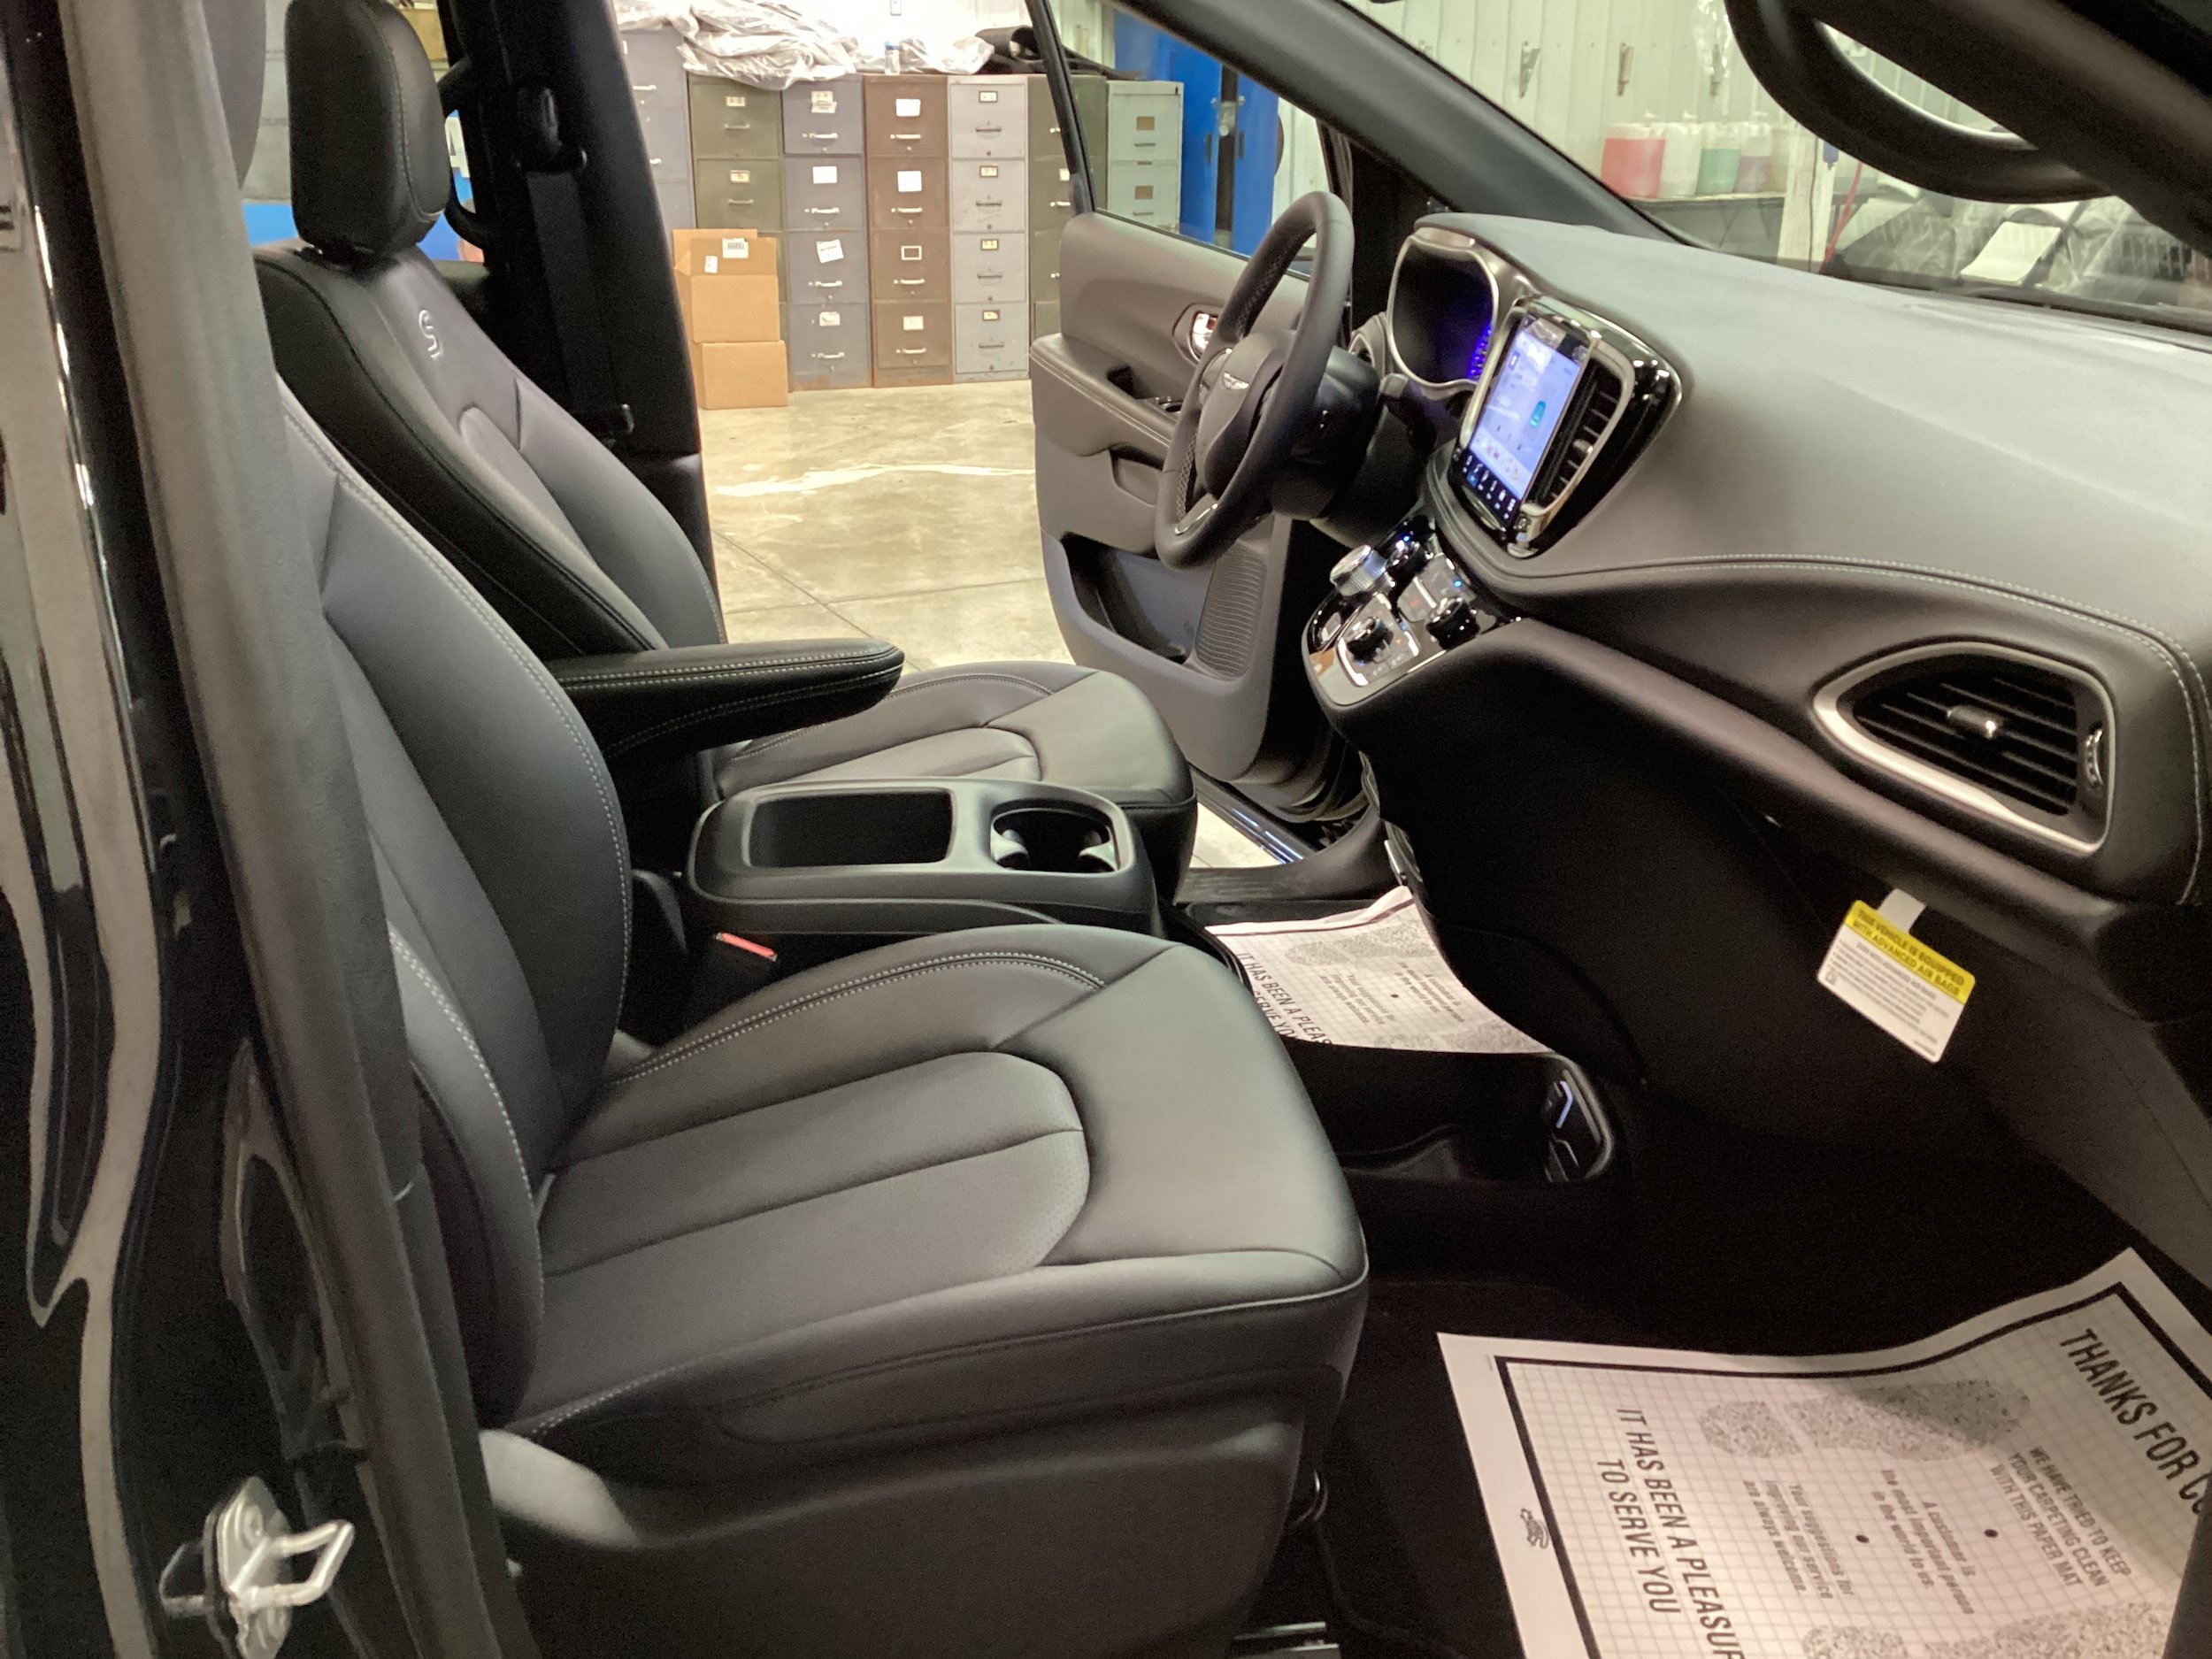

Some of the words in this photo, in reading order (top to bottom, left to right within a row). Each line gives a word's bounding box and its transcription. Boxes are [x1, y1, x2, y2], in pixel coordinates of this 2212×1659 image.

[1872, 933, 1917, 968] ADVANCED
[1917, 965, 1934, 978] AIR
[1934, 975, 1960, 996] BAGS
[1875, 924, 1908, 949] VEHICLE
[1919, 952, 1964, 986] EQUIPPED
[1245, 961, 1272, 981] HAS
[1262, 982, 1296, 1006] BEEN
[1617, 1409, 1647, 1425] IT
[2060, 1328, 2158, 1425] THANKS
[2133, 1422, 2200, 1480] FOR
[1596, 1459, 1630, 1484] TO
[1625, 1432, 1665, 1471] HAS
[1609, 1492, 1660, 1557] SERVE
[1644, 1479, 1690, 1529] BEEN
[1753, 1501, 1780, 1538] always
[1990, 1464, 2020, 1494] WITH
[2009, 1494, 2038, 1521] THIS
[2027, 1522, 2063, 1560] PAPER
[2053, 1562, 2082, 1586] MAT
[2008, 1453, 2038, 1484] YOUR
[2028, 1483, 2081, 1547] CARPETING
[2072, 1548, 2109, 1586] CLEAN
[2030, 1446, 2051, 1464] WE
[2041, 1464, 2071, 1494] HAVE
[2063, 1494, 2096, 1528] TRIED
[2088, 1528, 2108, 1546] TO
[2100, 1546, 2131, 1576] KEEP
[1667, 1536, 1698, 1549] A
[1789, 1485, 1809, 1507] Your
[1801, 1509, 1845, 1576] suggestions
[1837, 1580, 1855, 1595] for
[1638, 1566, 1681, 1613] YOU
[1803, 1556, 1834, 1599] service
